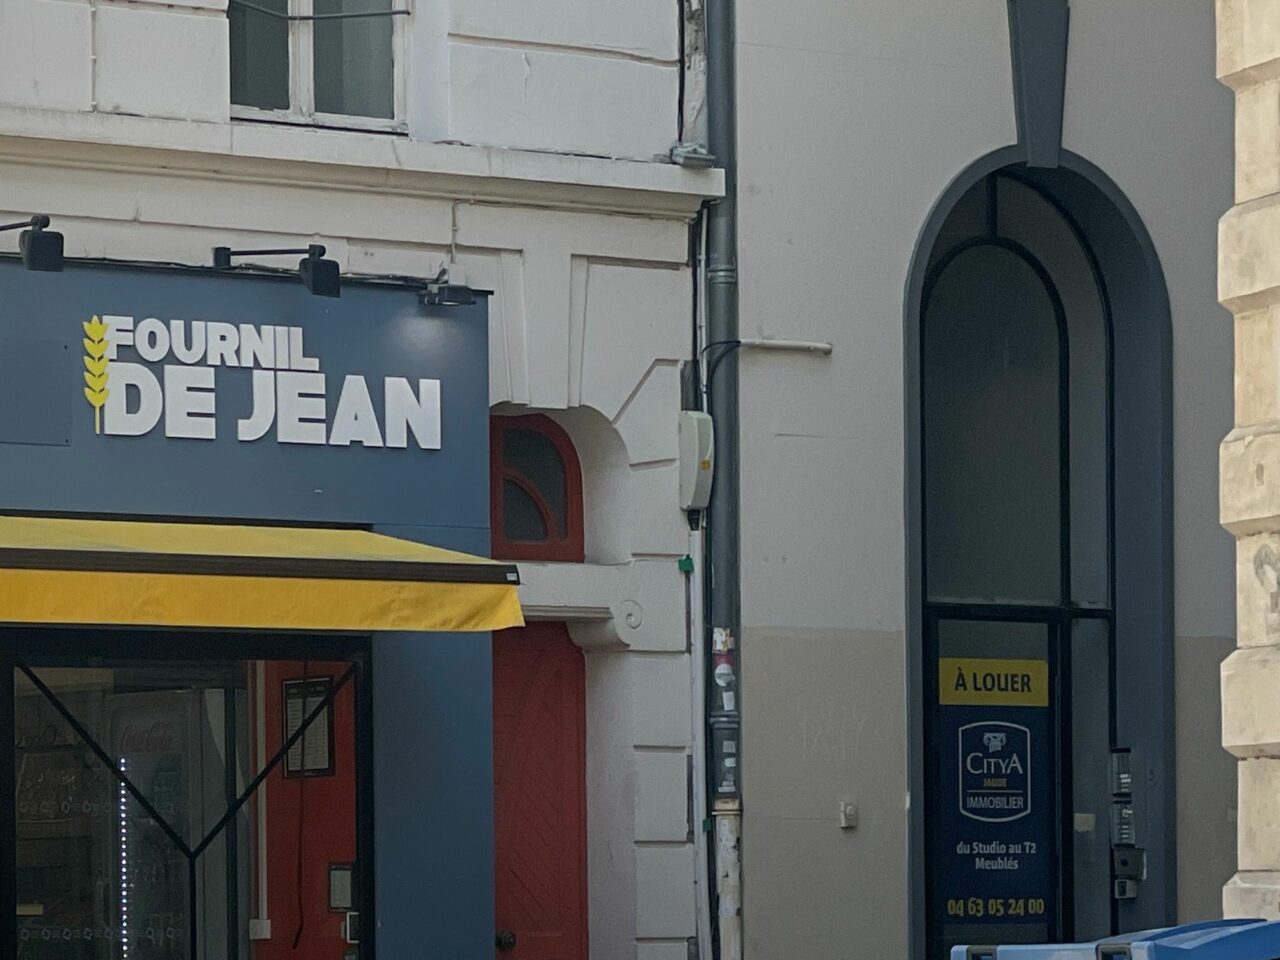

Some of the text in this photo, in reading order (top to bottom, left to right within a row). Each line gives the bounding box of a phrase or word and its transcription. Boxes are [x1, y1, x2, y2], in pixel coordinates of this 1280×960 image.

[102, 315, 320, 372] FOURNIL
[104, 361, 441, 450] DE JEAN
[954, 667, 1032, 693] À LOUER
[966, 796, 1024, 809] IMMOBILIER
[956, 841, 1037, 854] du Studio au T2
[975, 856, 1019, 870] Meublés
[947, 897, 1045, 917] 04 63 05 24 00
